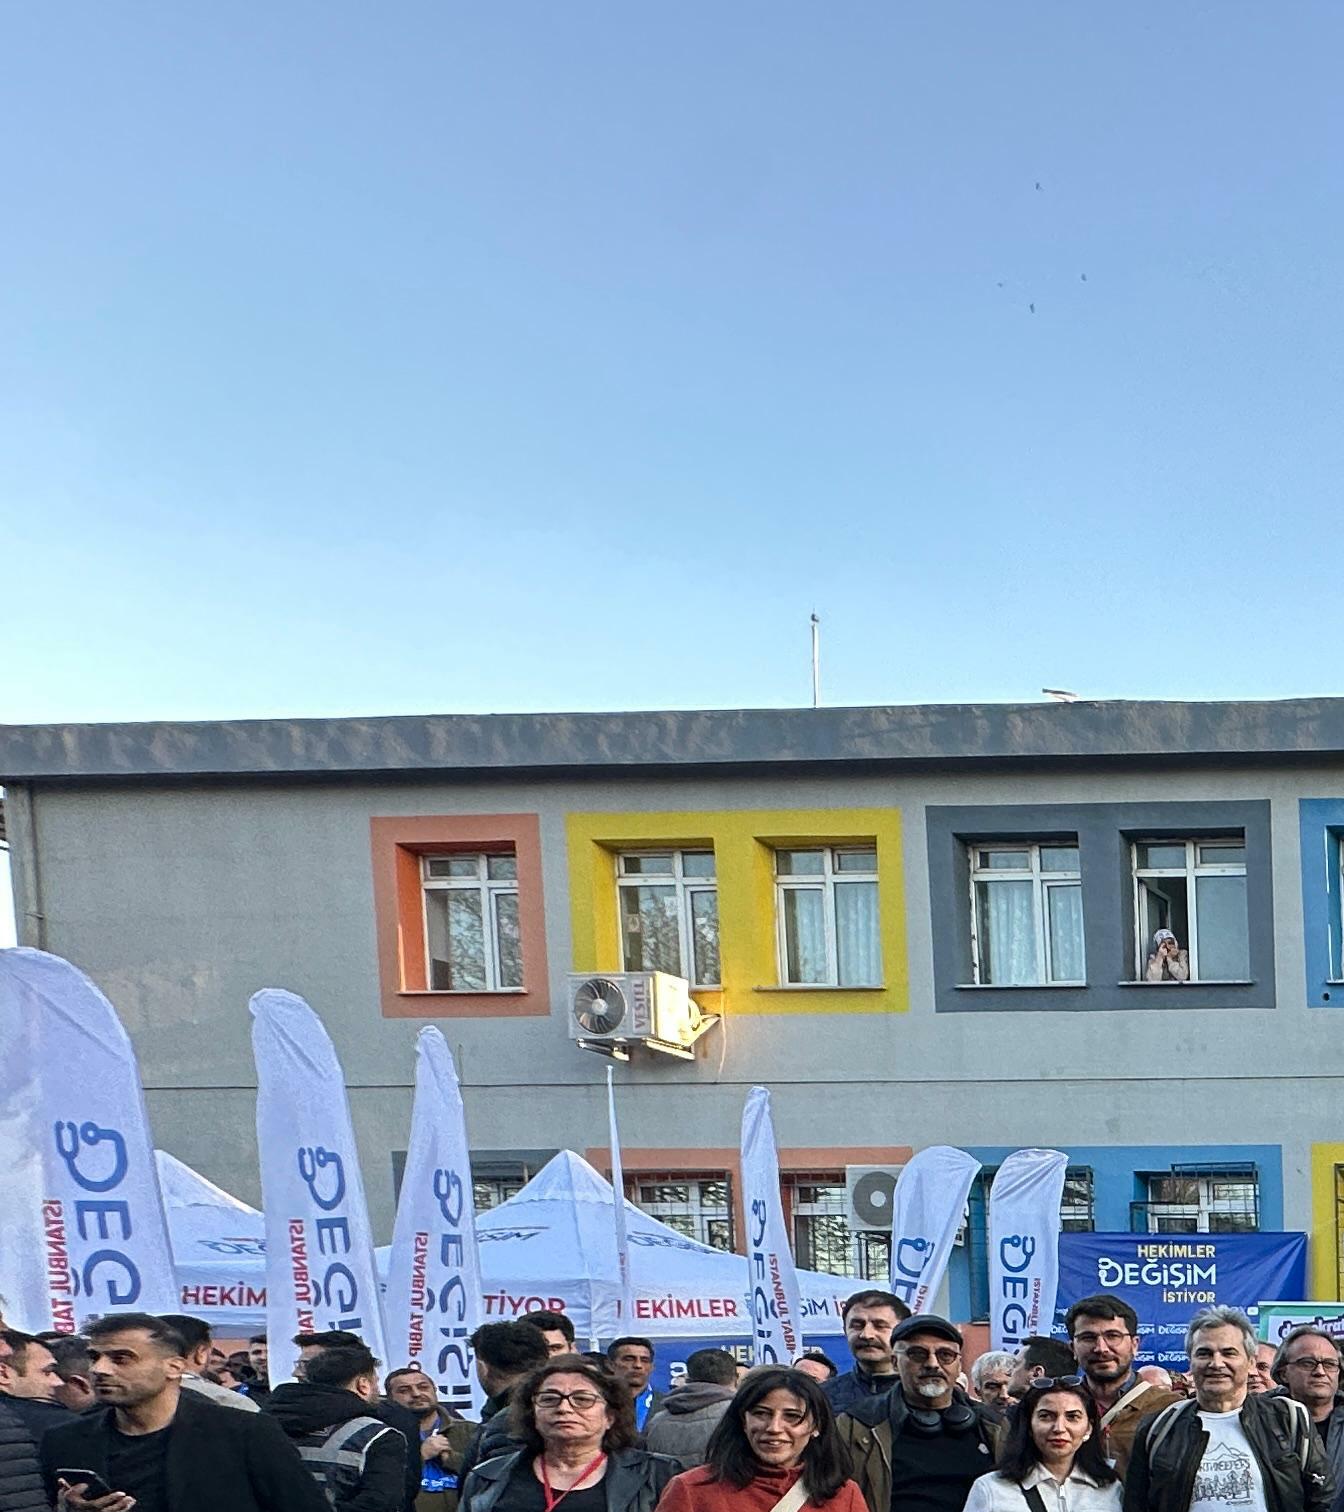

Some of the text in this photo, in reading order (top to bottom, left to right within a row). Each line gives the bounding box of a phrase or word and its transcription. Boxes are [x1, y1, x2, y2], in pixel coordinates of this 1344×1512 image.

[1137, 1241, 1216, 1258] HEKİMLER
[1097, 1257, 1217, 1288] DEĞİŞİM
[182, 1281, 267, 1307] HEKİM
[483, 1290, 566, 1316] TİYOR
[1163, 1288, 1216, 1303] İSTİYOR
